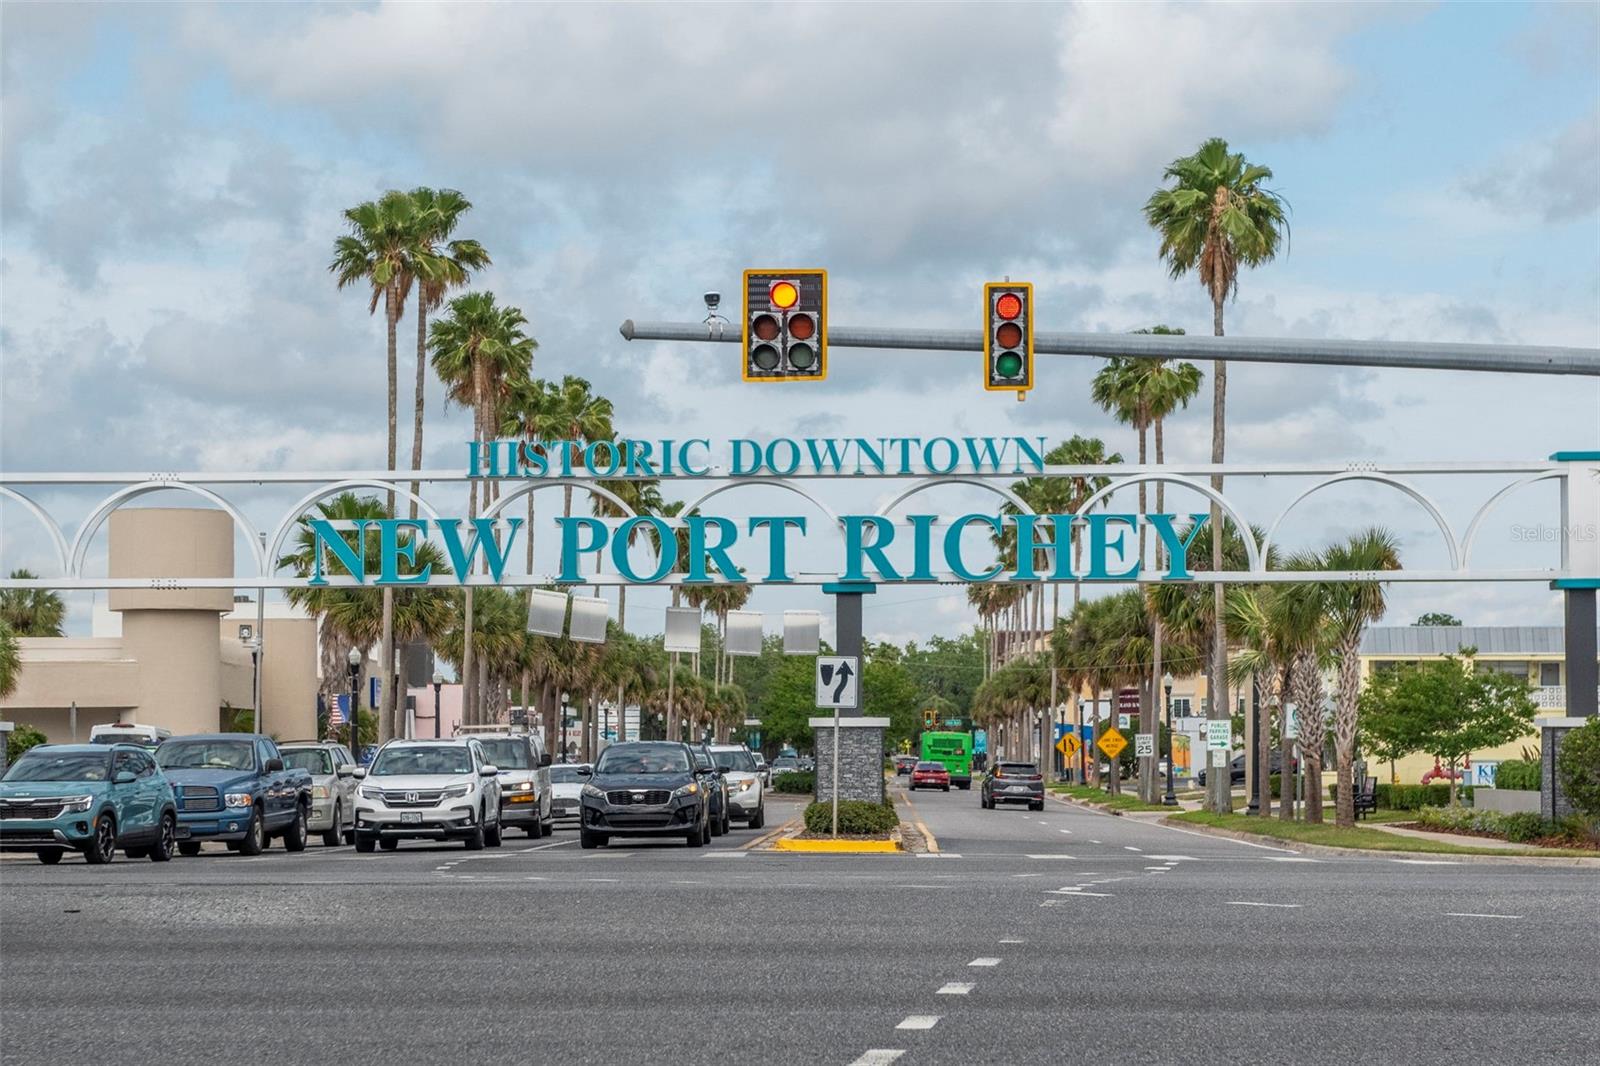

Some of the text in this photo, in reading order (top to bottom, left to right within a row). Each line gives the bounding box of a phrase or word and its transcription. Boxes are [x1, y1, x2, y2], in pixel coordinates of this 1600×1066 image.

[466, 436, 1048, 478] HISTORIC DOWNTOWN
[307, 514, 1211, 586] NEW PORT RICHEY
[1137, 745, 1152, 754] 25
